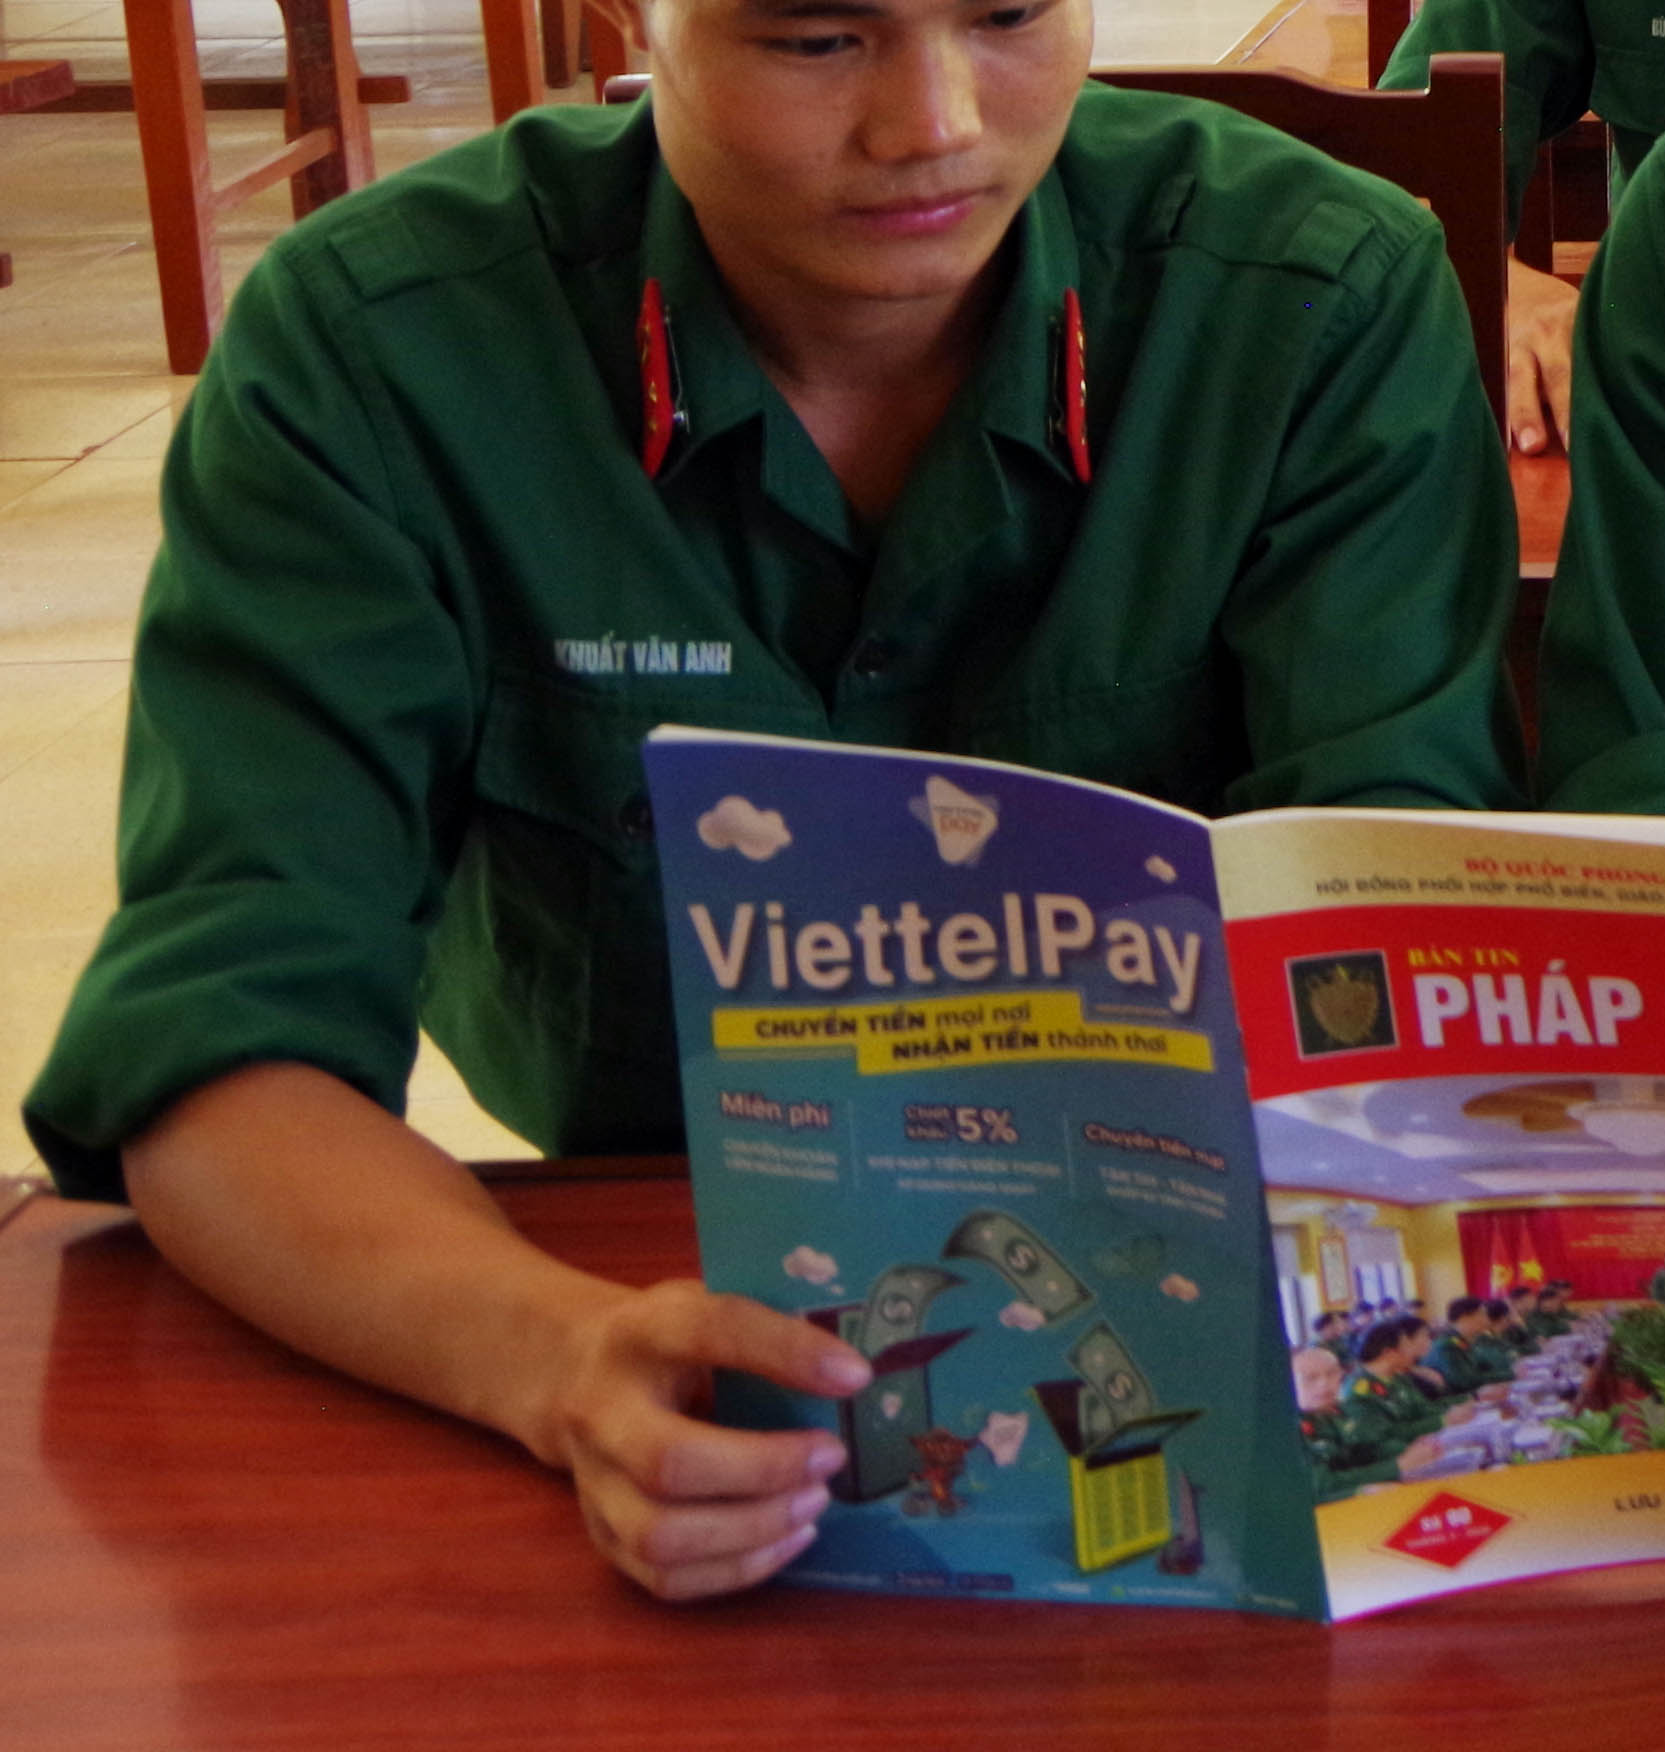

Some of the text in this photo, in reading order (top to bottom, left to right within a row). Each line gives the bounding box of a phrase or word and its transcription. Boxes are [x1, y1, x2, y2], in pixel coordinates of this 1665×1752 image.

[632, 634, 679, 674] VĂN
[685, 640, 732, 675] ANH
[687, 891, 1202, 1013] ViettelPay
[1473, 947, 1521, 968] TIN
[755, 1009, 858, 1041] CHUYỂN
[868, 1005, 927, 1034] TIỀN
[1412, 959, 1645, 1049] PHÁP
[891, 1031, 972, 1064] NHẬN
[981, 1023, 1041, 1052] TIỀN
[955, 1105, 1020, 1144] 5%
